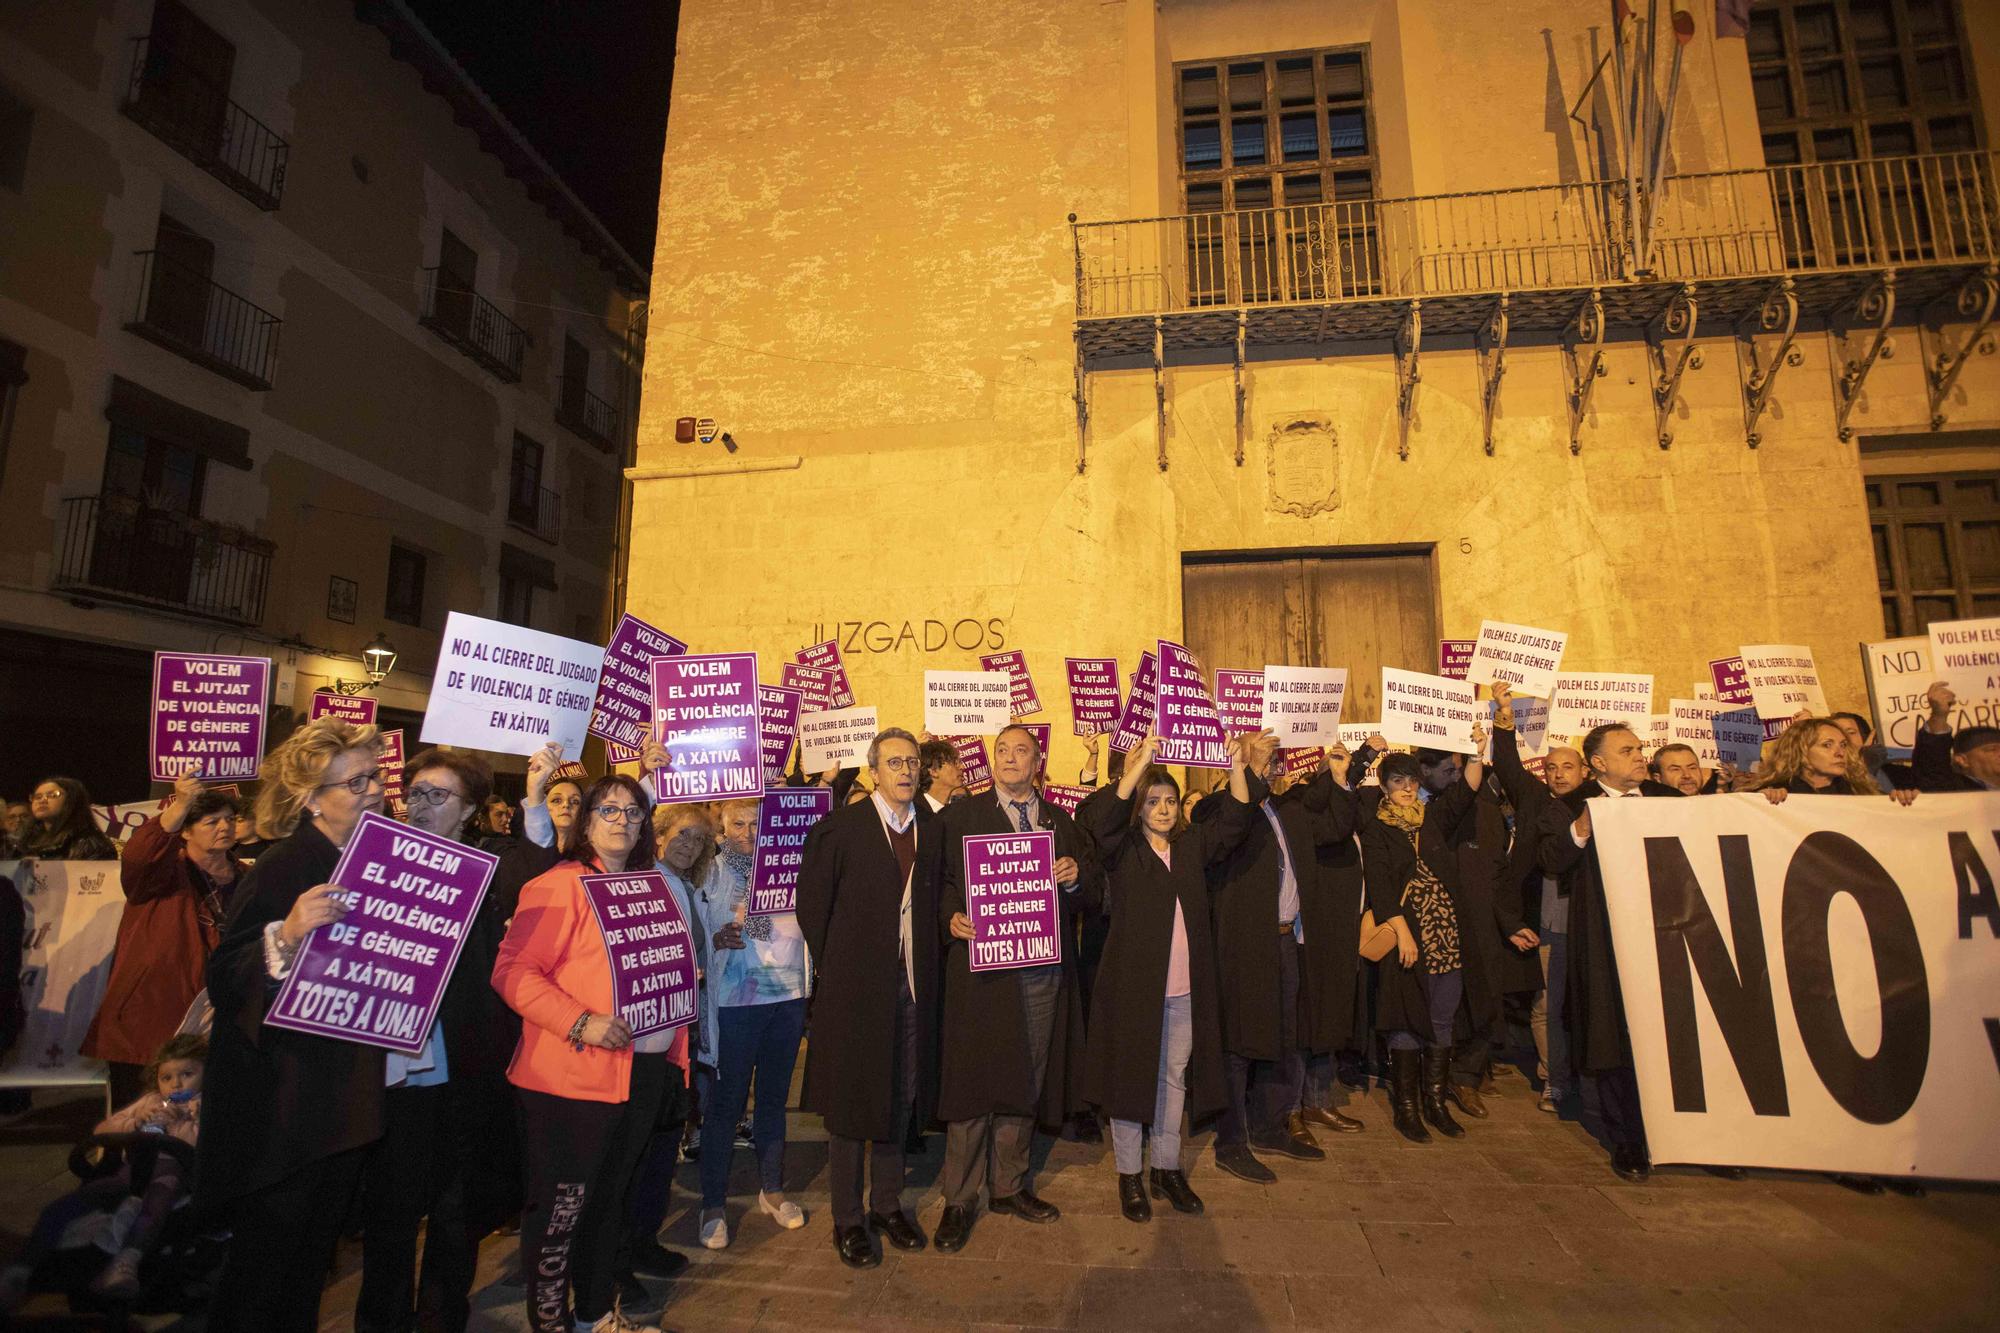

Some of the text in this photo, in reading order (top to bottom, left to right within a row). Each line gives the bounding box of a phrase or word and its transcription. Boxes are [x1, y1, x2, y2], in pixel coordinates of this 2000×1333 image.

[1460, 537, 1472, 554] 5
[636, 628, 670, 653] VOLEM
[1483, 628, 1562, 652] VOLEM ELS JUTJATS DE
[1938, 630, 1978, 644] VOLEM
[621, 642, 632, 656] EL
[452, 639, 597, 683] NO AL CIERRE DEL JUZGADO
[604, 656, 618, 670] DE
[1076, 663, 1103, 671] VOLEM
[1479, 647, 1555, 671] VIOLÈNCIA DE GÈNERE
[1882, 651, 1920, 673] NO
[185, 662, 241, 676] VOLEM
[678, 662, 731, 678] VOLEM
[1170, 667, 1181, 678] EL
[1492, 668, 1524, 684] A XÀTIVA
[173, 681, 250, 695] EL JUTJAT
[601, 675, 614, 690] DE
[669, 683, 741, 698] EL JUTJAT
[929, 682, 1007, 692] NO AL CIERRE DEL JUZGADO
[1071, 686, 1079, 694] DE
[1161, 684, 1174, 695] DE
[1557, 680, 1649, 693] VOLEM ELS JUTJATS DE
[1987, 677, 1994, 688] A
[447, 671, 590, 712] DE VIOLENCIA DE GÉNERO
[1388, 682, 1472, 704] NO AL CIERRE DEL JUZGADO
[159, 700, 260, 714] DE VIOLÈNCIA
[328, 698, 361, 708] VOLEM
[596, 694, 641, 720] A XÀTIVA
[930, 698, 938, 707] DE
[941, 698, 972, 707] VIOLENCIA
[975, 698, 982, 708] DE
[1168, 703, 1181, 714] DE
[1388, 700, 1397, 710] DE
[1400, 702, 1434, 716] VIOLENCIA
[1437, 706, 1445, 717] DE
[1601, 700, 1611, 710] DE
[659, 703, 754, 721] DE VIOLÈNCIA
[954, 714, 962, 723] EN
[167, 719, 250, 733] DE GÈNERE
[490, 711, 550, 735] EN XÀTIVA
[608, 716, 616, 734] A
[1172, 722, 1218, 737] A XÀTIVA
[1414, 722, 1422, 732] EN
[173, 738, 241, 752] A XÀTIVA
[1195, 742, 1202, 760] A
[676, 749, 741, 765] A XÀTIVA
[206, 758, 216, 776] A
[221, 757, 254, 775] UNA!
[664, 767, 756, 796] TOTES A UNA!
[392, 836, 462, 875] VOLEM
[987, 841, 1031, 856] VOLEM
[980, 860, 1040, 875] EL JUTJAT
[362, 862, 463, 906] EL JUTJAT
[605, 880, 651, 896] VOLEM
[971, 878, 1052, 896] DE VIOLÈNCIA
[608, 900, 667, 919] EL JUTJAT
[980, 899, 1046, 916] DE GÈNERE
[364, 896, 463, 940] VIOLÈNCIA
[606, 920, 686, 945] DE VIOLÈNCIA
[988, 919, 1041, 936] A XÀTIVA
[328, 922, 440, 966] DE GÈNERE
[977, 936, 1053, 964] TOTES A UNA!
[621, 944, 685, 970] DE GÈNERE
[324, 958, 416, 995] A XÀTIVA
[632, 970, 683, 996] A XÀTIVA
[1643, 831, 1931, 1125] NO
[288, 981, 426, 1039] TOTES A UNA!
[621, 989, 693, 1031] TOTES A UNA!
